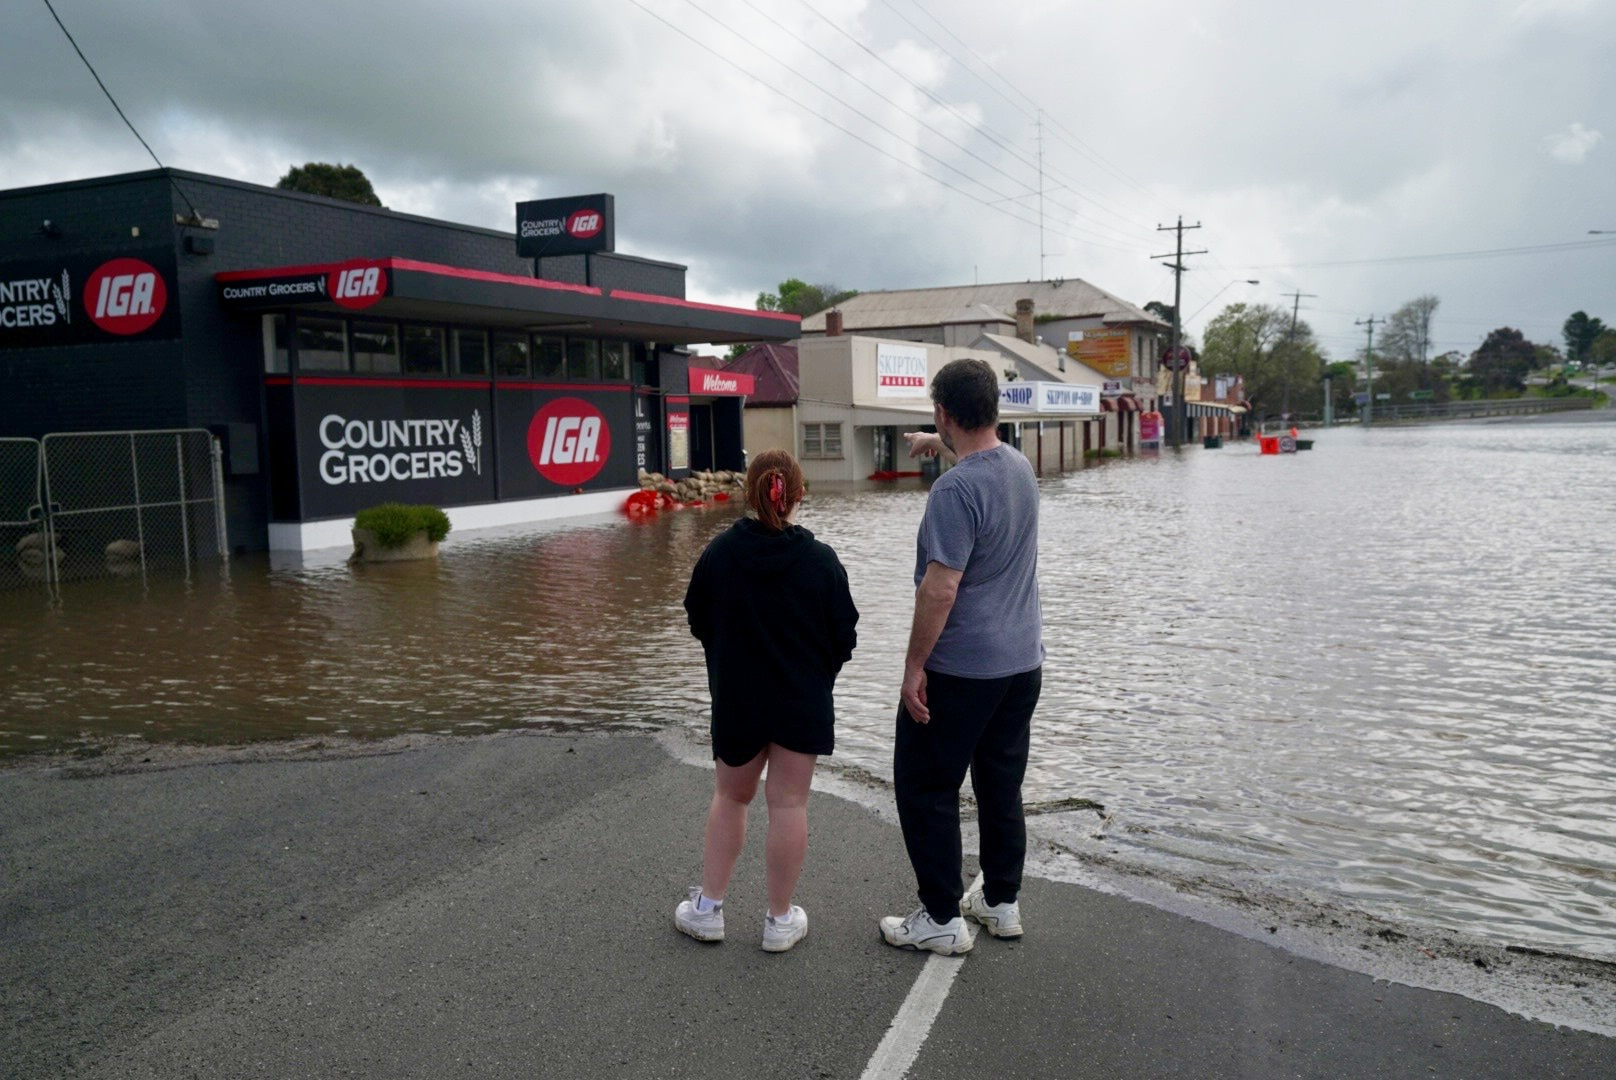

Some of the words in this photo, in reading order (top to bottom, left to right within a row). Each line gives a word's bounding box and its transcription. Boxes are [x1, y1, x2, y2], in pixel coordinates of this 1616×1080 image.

[521, 219, 559, 230] COUNTRY
[521, 227, 560, 238] GROCERS
[572, 214, 599, 233] IGA
[0, 278, 51, 303] NTRY
[223, 283, 267, 299] COUNTRY
[269, 281, 316, 296] GROCERS
[336, 267, 379, 299] IGA
[95, 272, 156, 318] IGA
[0, 304, 56, 328] CERS
[879, 354, 926, 375] SKIPTON
[703, 374, 738, 392] Welcome
[998, 386, 1032, 405] -SHOP
[1046, 389, 1071, 405] SKIPTON
[319, 414, 460, 449] COUNTRY
[539, 416, 601, 465] IGA
[319, 449, 463, 485] GROCERS
